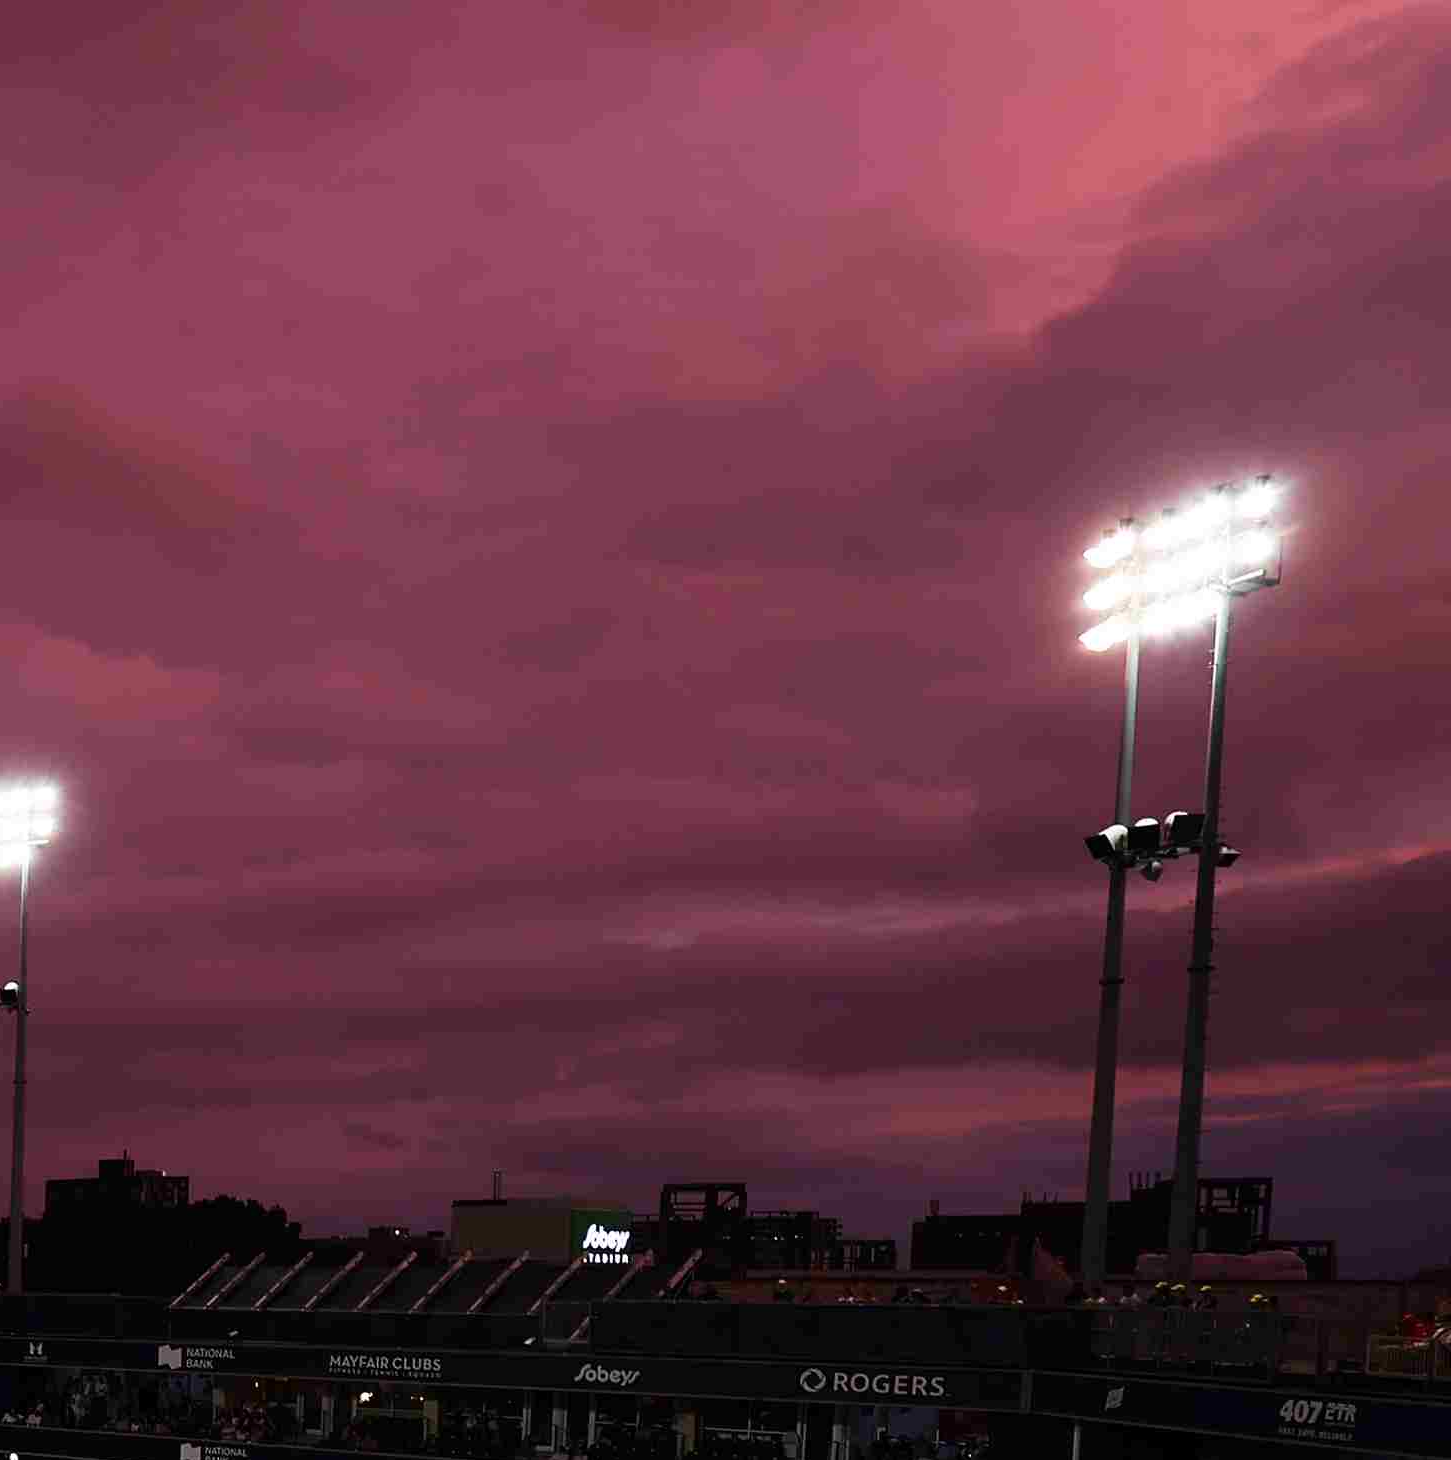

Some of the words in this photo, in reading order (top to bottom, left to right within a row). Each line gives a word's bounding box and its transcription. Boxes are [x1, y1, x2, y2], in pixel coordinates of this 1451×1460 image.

[186, 1346, 236, 1360] NATIONAL
[186, 1358, 215, 1369] BANK
[329, 1355, 390, 1369] MAYFAIR
[391, 1356, 442, 1372] CLUBS
[573, 1363, 642, 1387] Sobeys
[833, 1372, 946, 1397] ROGERS
[1280, 1399, 1323, 1424] 407
[1324, 1402, 1356, 1421] ETR
[204, 1447, 248, 1457] NATIONAL
